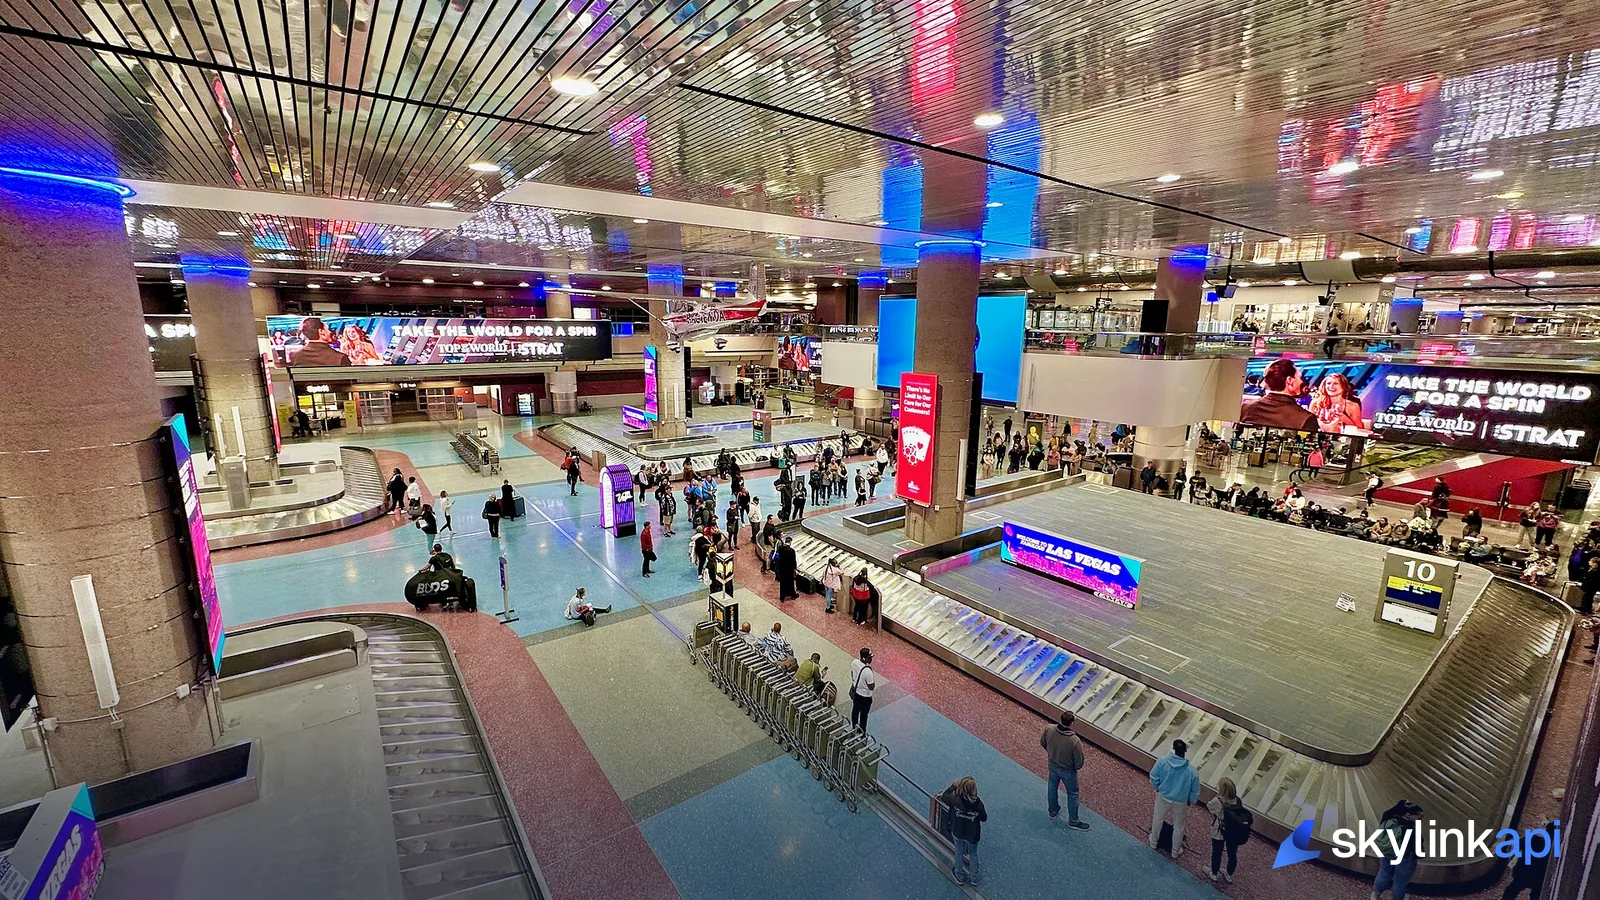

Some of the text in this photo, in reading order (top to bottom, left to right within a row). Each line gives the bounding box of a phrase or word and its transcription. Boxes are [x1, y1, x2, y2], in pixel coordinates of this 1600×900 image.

[391, 325, 597, 337] TAKE THE WORLD FOR A SPIN
[438, 343, 461, 353] TOP
[470, 337, 508, 353] WORLD
[521, 342, 564, 355] STRAT
[1385, 375, 1592, 401] TAKE THE WORLD
[1413, 391, 1546, 414] FOR A SPIN
[756, 412, 761, 420] 9
[1375, 412, 1406, 425] TOP
[1417, 412, 1476, 432] WORLD
[1497, 424, 1585, 448] STRAT
[1046, 542, 1073, 560] LAS
[1074, 551, 1122, 576] VEGAS
[1403, 560, 1436, 582] 10
[416, 579, 450, 594] BUDS
